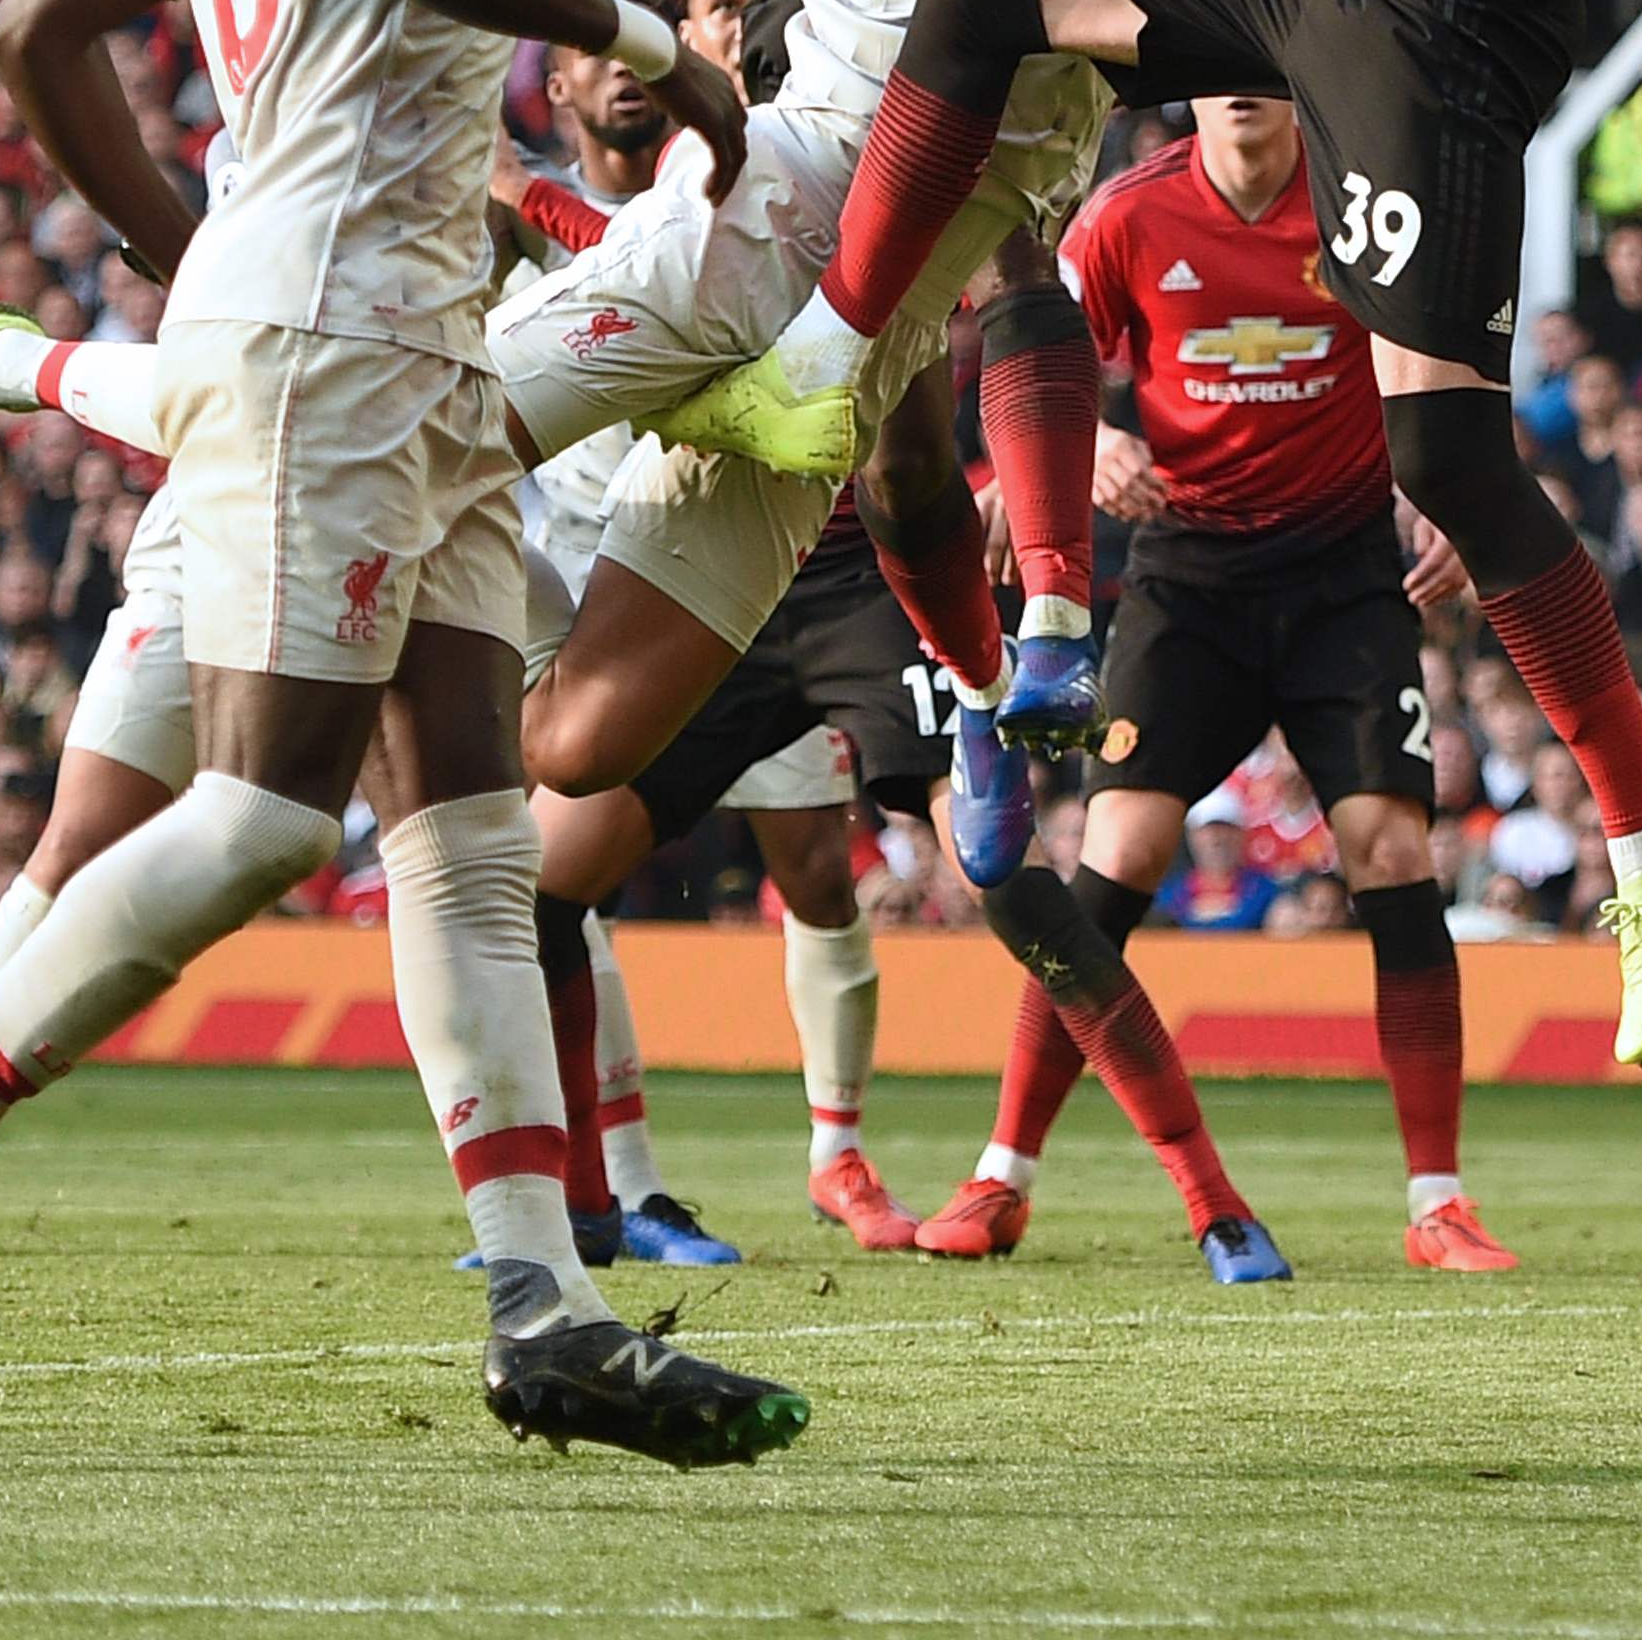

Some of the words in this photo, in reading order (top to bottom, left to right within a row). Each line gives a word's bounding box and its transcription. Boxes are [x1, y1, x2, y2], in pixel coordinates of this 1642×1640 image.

[1331, 171, 1422, 287] 39
[1183, 374, 1338, 403] CHEVROLET
[336, 622, 377, 641] LFC
